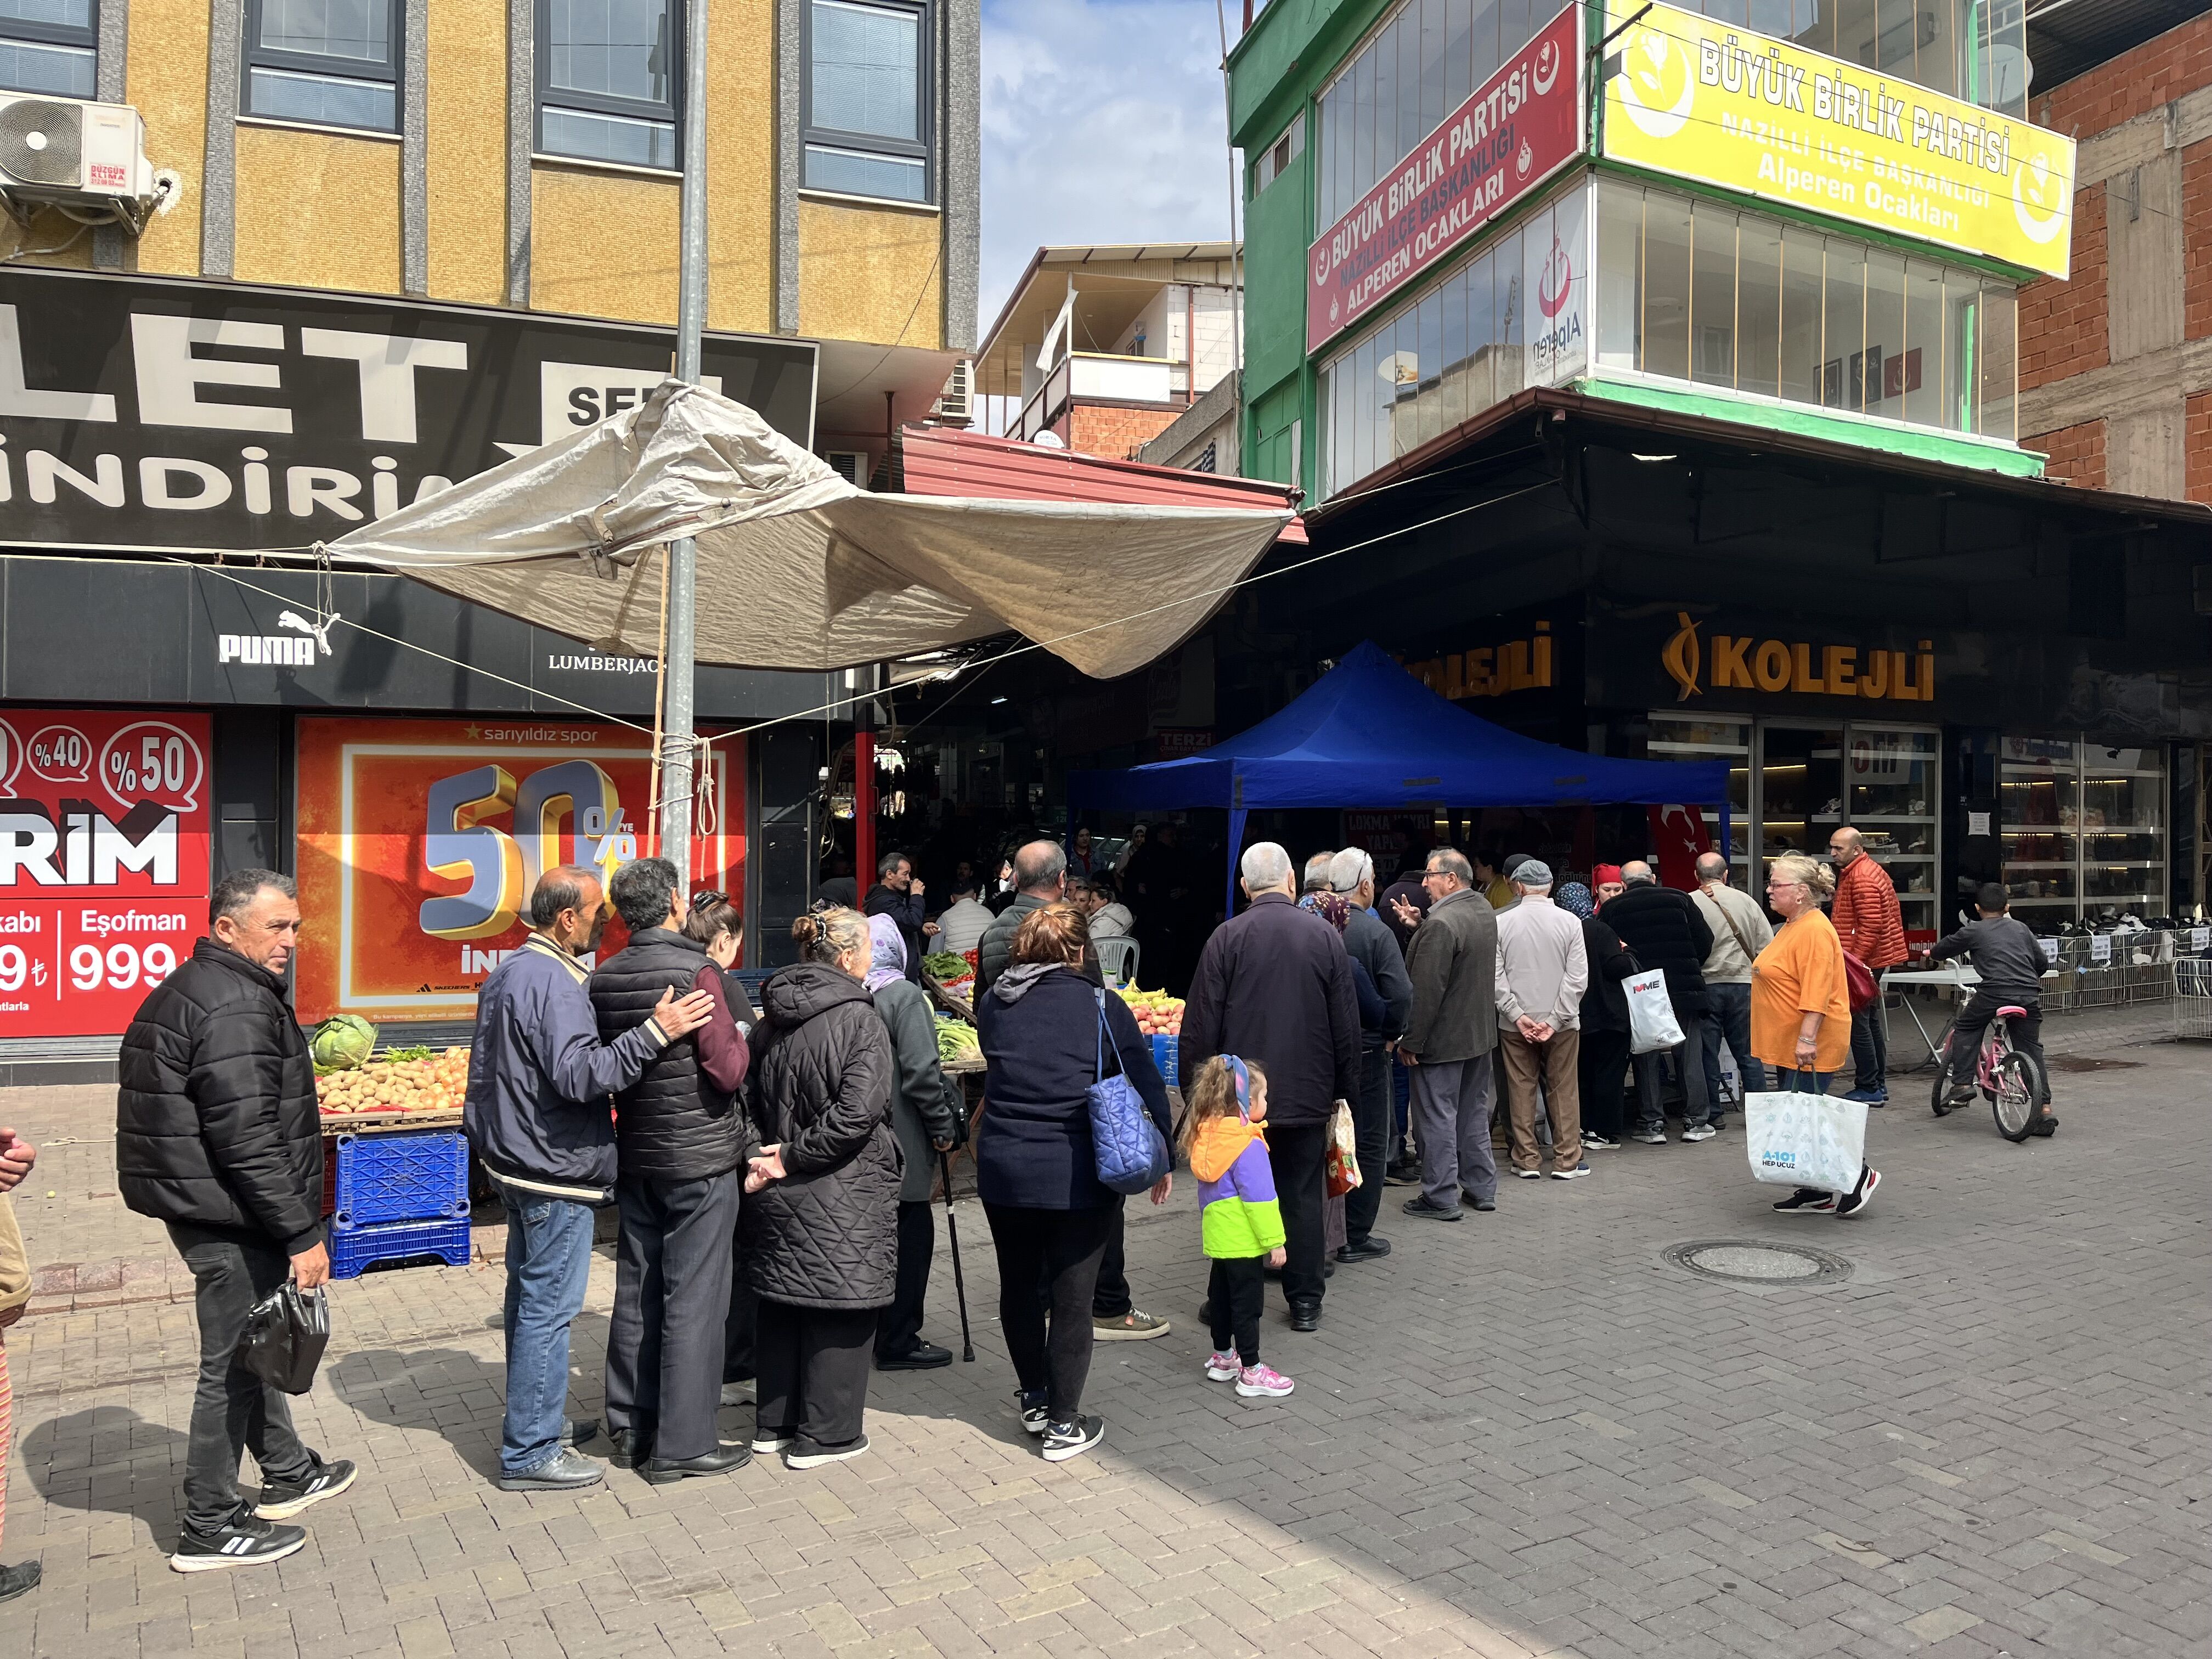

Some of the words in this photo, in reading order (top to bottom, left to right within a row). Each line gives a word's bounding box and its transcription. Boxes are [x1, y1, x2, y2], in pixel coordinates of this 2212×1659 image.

[1699, 33, 1805, 114] BÜYÜK
[1813, 68, 1906, 144] BİRLİK
[1911, 104, 2011, 176] PARTİSİ
[1331, 193, 1384, 269] BÜYÜK
[1387, 141, 1444, 221] BİRLİK
[1449, 61, 1528, 168] PARTİSİ
[1721, 112, 1810, 157] NAZİLLİ
[1819, 136, 1865, 175] İLÇE
[1874, 154, 1990, 209] BAŞKANLIĞI
[1757, 153, 1855, 204] Alperen
[1865, 180, 1959, 230] Ocakları
[1339, 235, 1386, 290] NAZİLLİ
[1387, 213, 1416, 254] İLÇE
[1419, 123, 1515, 222] BAŞKANLIĞI
[1347, 250, 1410, 314] ALPEREN
[1415, 168, 1504, 260] OCAKLARI
[0, 303, 468, 443] LET
[219, 634, 315, 665] PUMA
[549, 654, 667, 675] LUMBERJAC
[1395, 620, 1551, 700] OLEJLİ
[1711, 635, 1934, 702] KOLEJLİ
[35, 735, 81, 768] %40
[111, 736, 185, 793] %50
[484, 727, 556, 743] sarıyıldız
[561, 730, 598, 744] spor
[1161, 733, 1211, 747] TERZİ
[81, 909, 186, 938] Eşofman
[69, 942, 188, 991] 999
[1763, 1150, 1796, 1163] A-101
